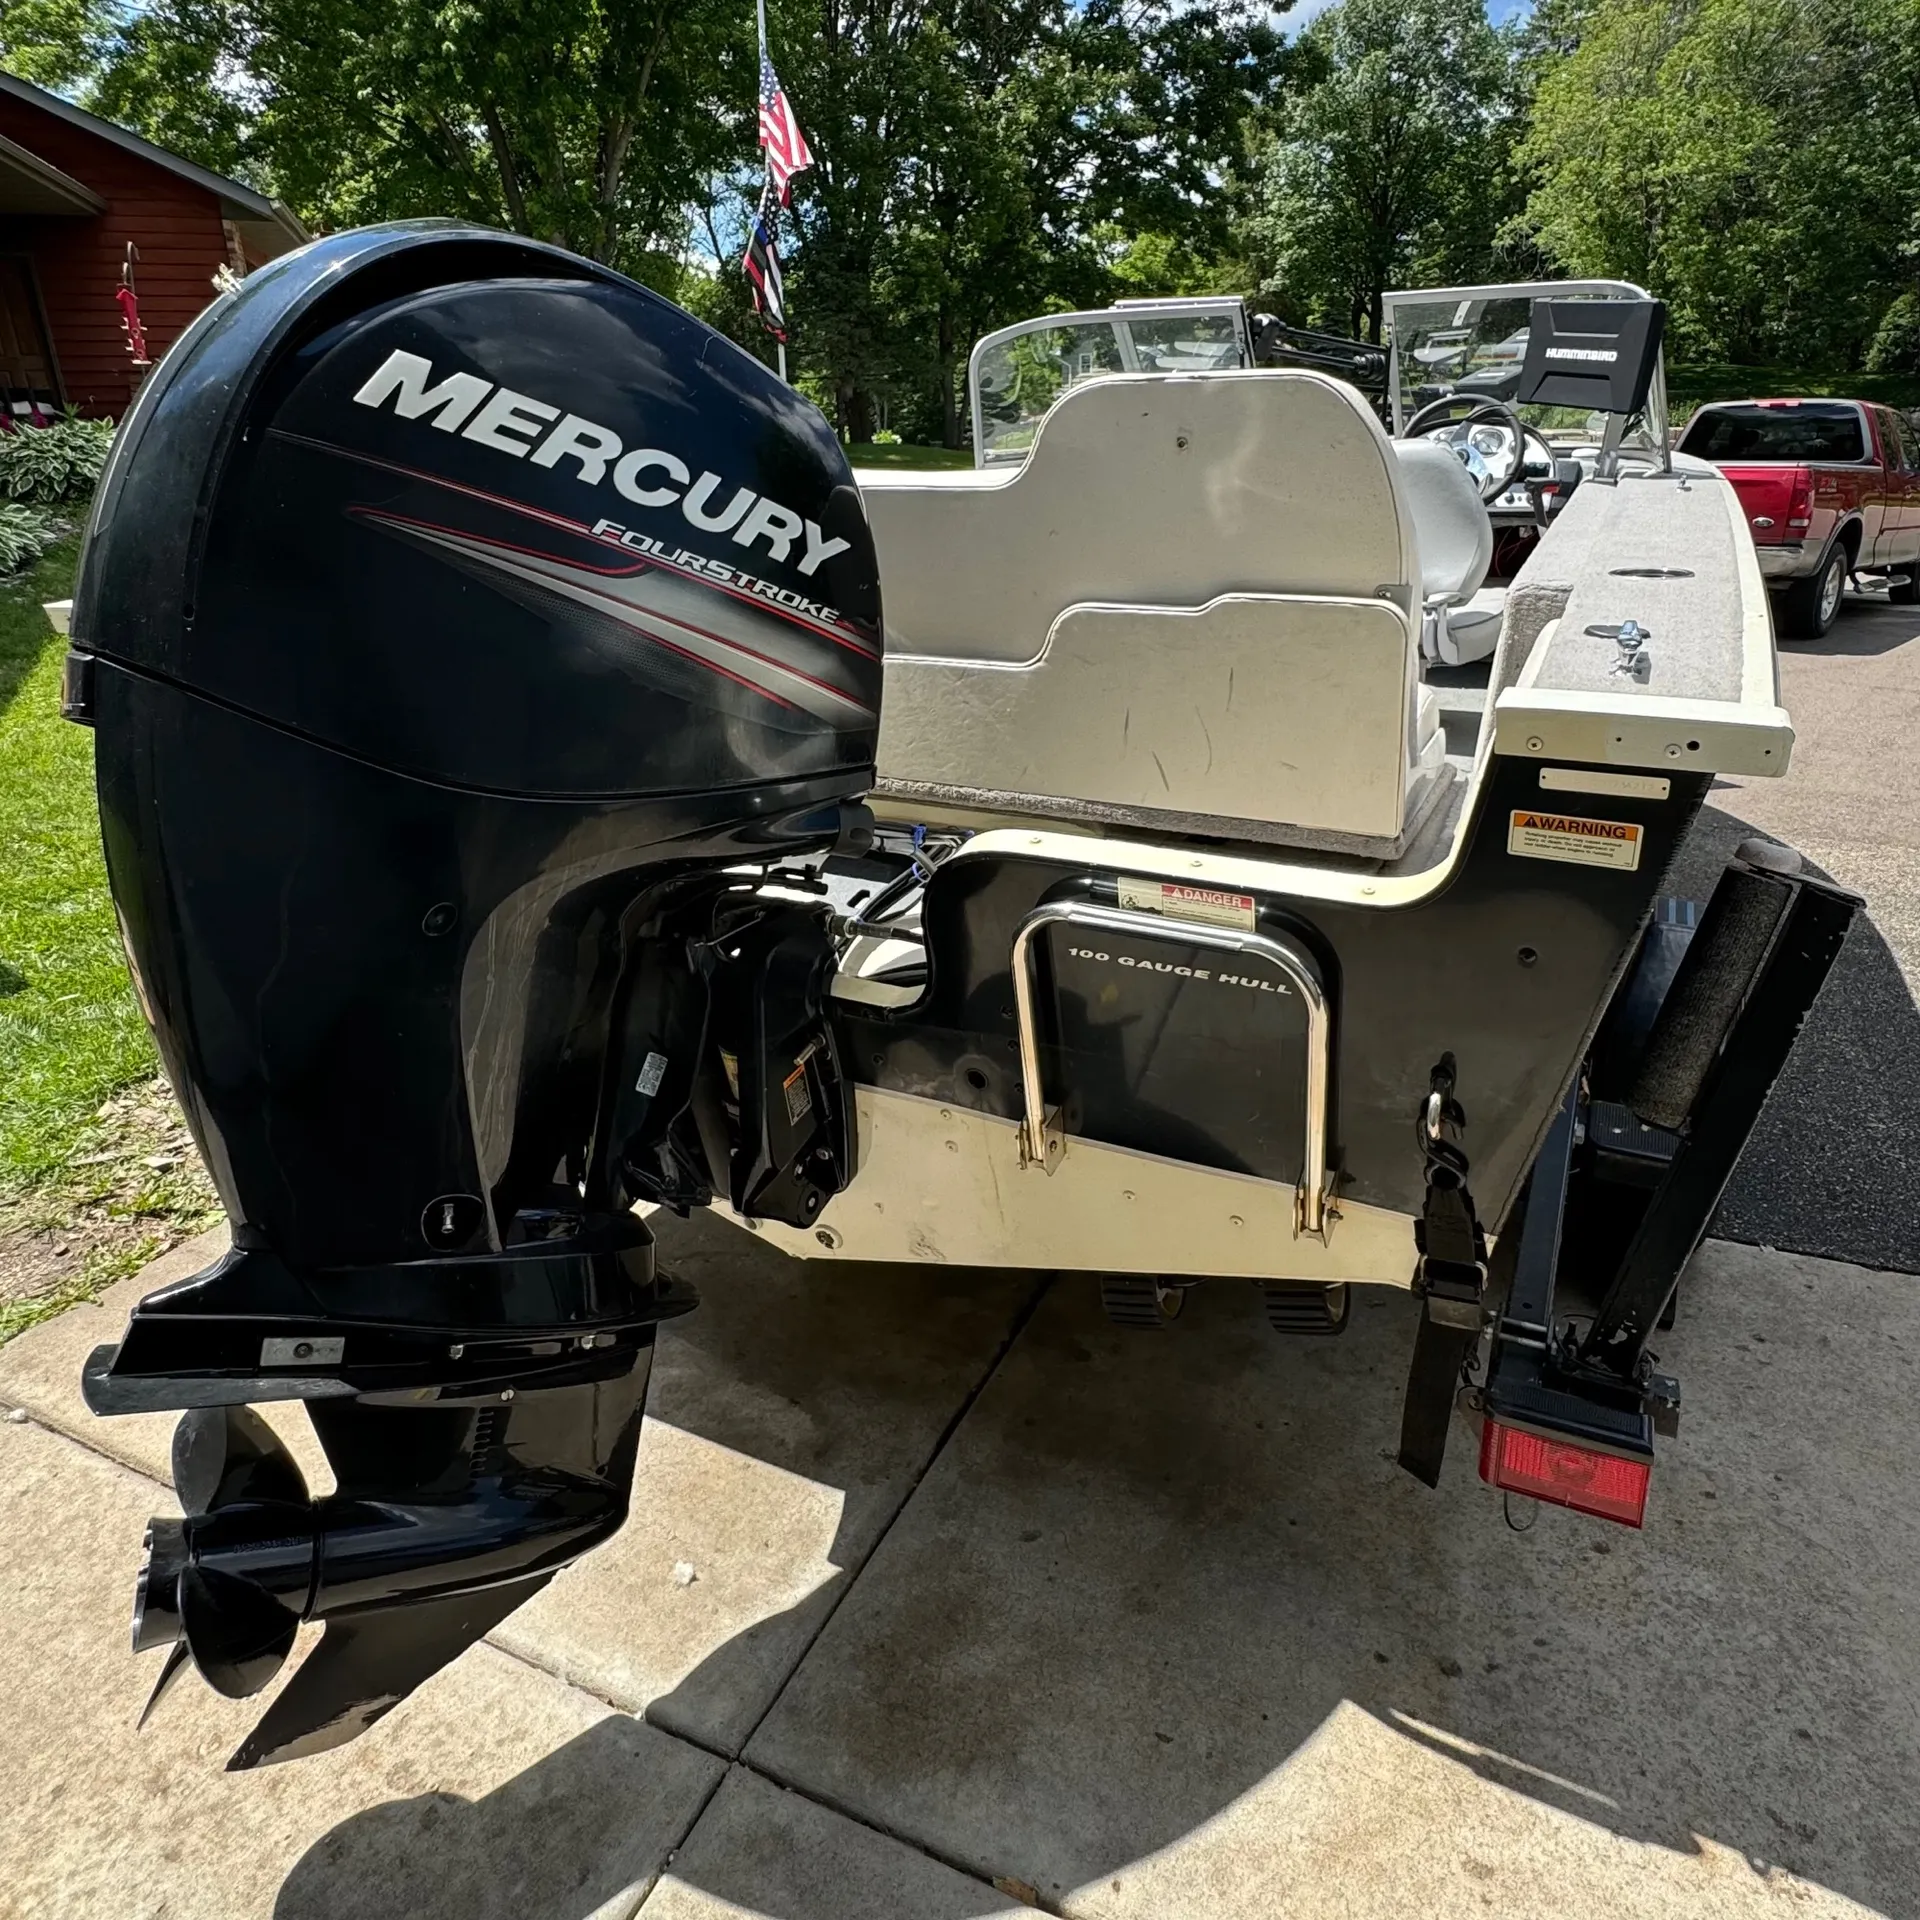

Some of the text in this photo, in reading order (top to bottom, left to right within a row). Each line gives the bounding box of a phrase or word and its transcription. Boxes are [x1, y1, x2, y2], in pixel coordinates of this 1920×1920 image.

[1545, 347, 1618, 362] HUMMINBIRD
[353, 349, 850, 577] MERCURY
[587, 518, 842, 625] FOURSTROKE
[1539, 817, 1627, 839] WARNING
[1183, 890, 1242, 908] DANGER
[1068, 947, 1293, 995] 100 GAUGE HULL
